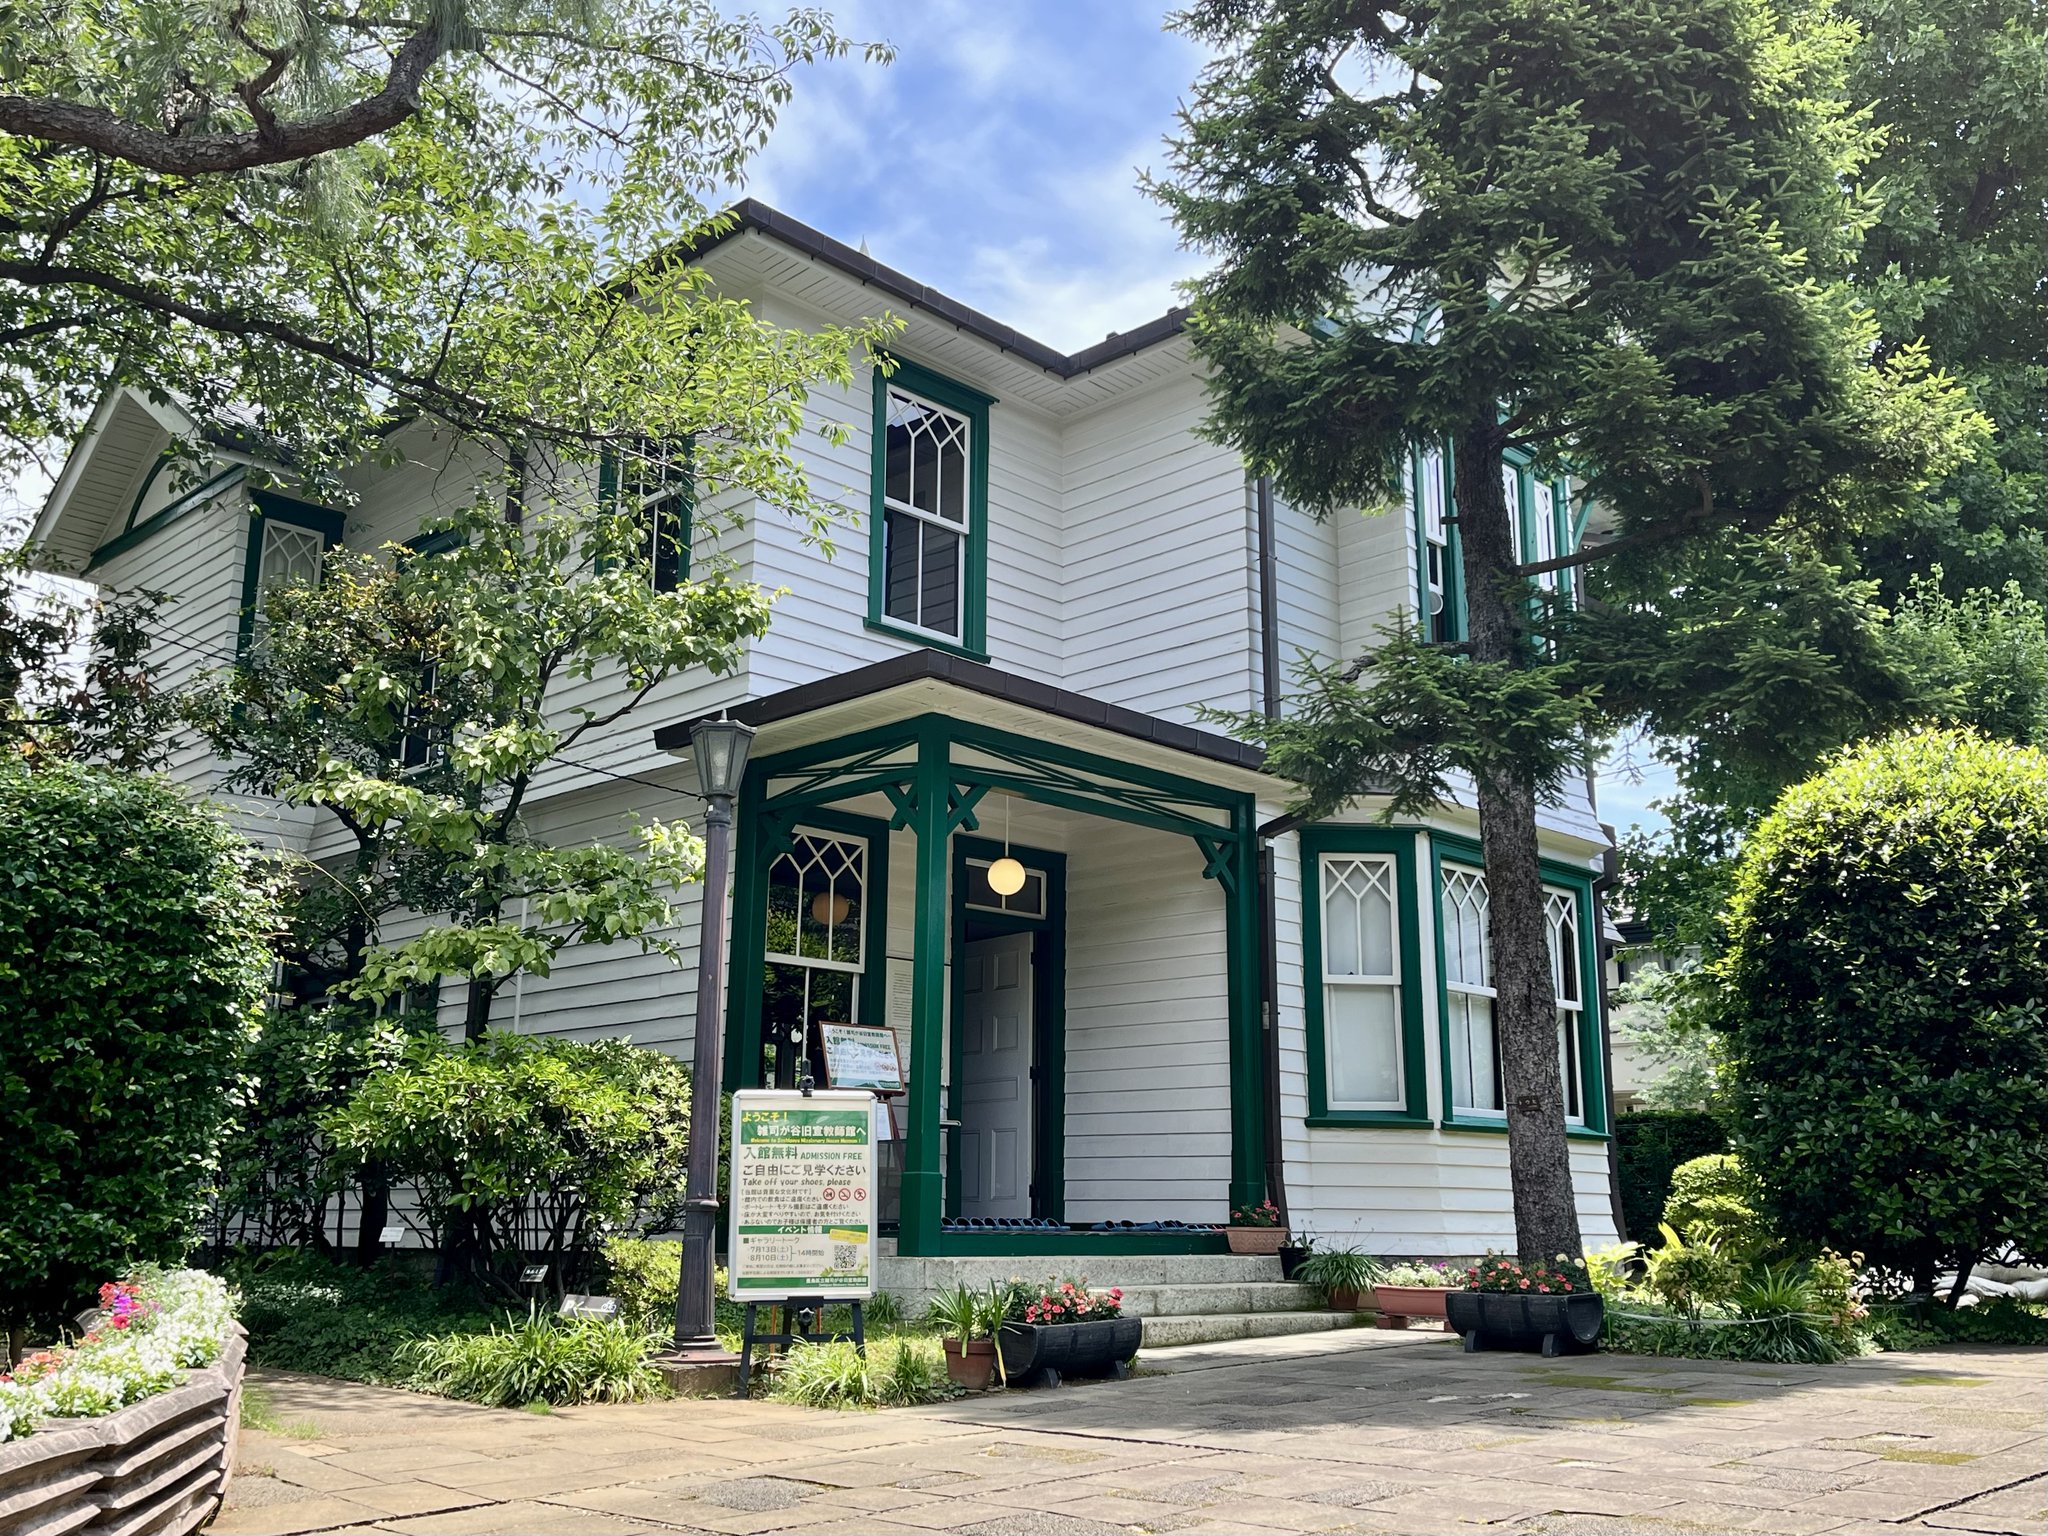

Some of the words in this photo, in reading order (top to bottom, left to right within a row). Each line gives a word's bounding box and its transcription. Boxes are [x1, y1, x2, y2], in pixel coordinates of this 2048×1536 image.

[742, 1111, 788, 1123] ようこそ！
[757, 1125, 867, 1137] 雑司が谷旧宣教師館へ
[743, 1146, 798, 1159] 入館無料
[800, 1152, 841, 1160] ADMISSION
[843, 1152, 863, 1160] FREE
[743, 1164, 867, 1177] ご自由にご見学ください
[743, 1178, 762, 1186] Take
[765, 1178, 778, 1186] off
[780, 1179, 799, 1187] your
[827, 1178, 852, 1187] please
[797, 1249, 825, 1257] 14時開始
